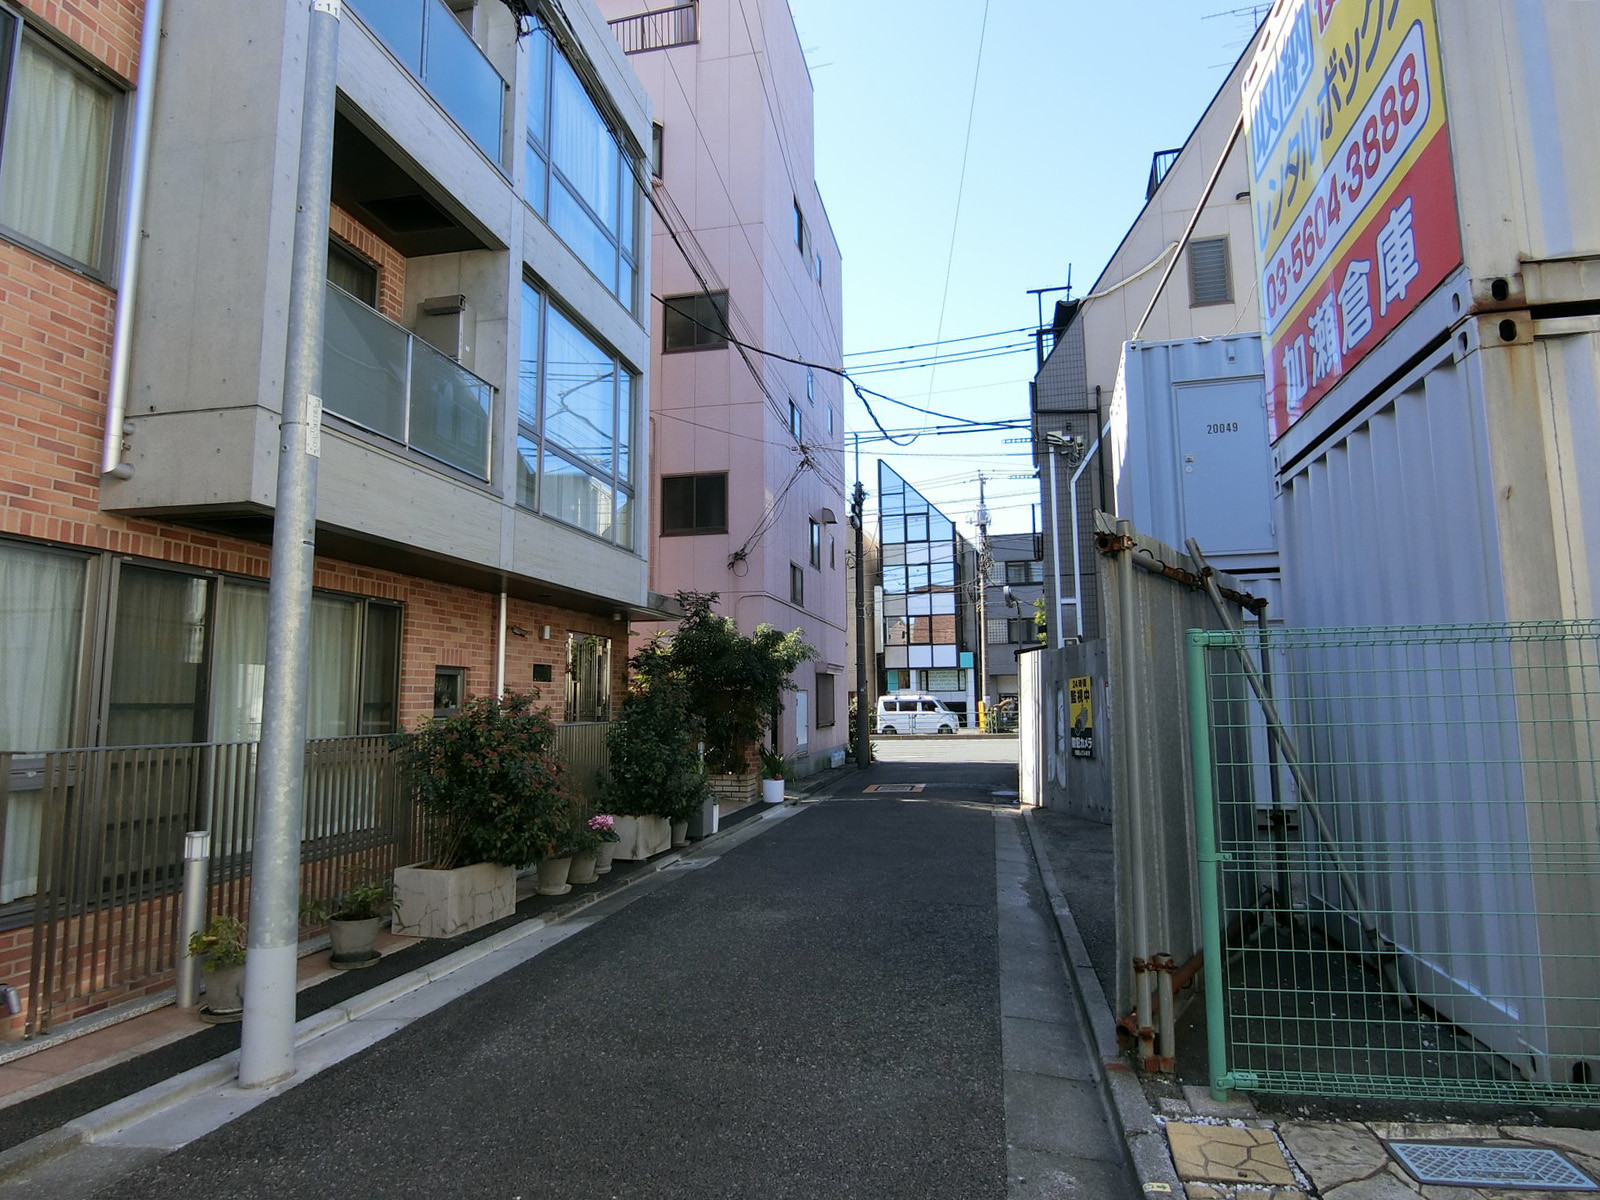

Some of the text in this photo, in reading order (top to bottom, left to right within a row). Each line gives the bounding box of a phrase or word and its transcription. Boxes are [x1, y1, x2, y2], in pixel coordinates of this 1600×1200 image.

[1257, 0, 1399, 251] レンタルボック
[1282, 196, 1420, 414] 加瀬倉庫
[1207, 422, 1238, 434] 20049
[1070, 689, 1091, 704] 監視中
